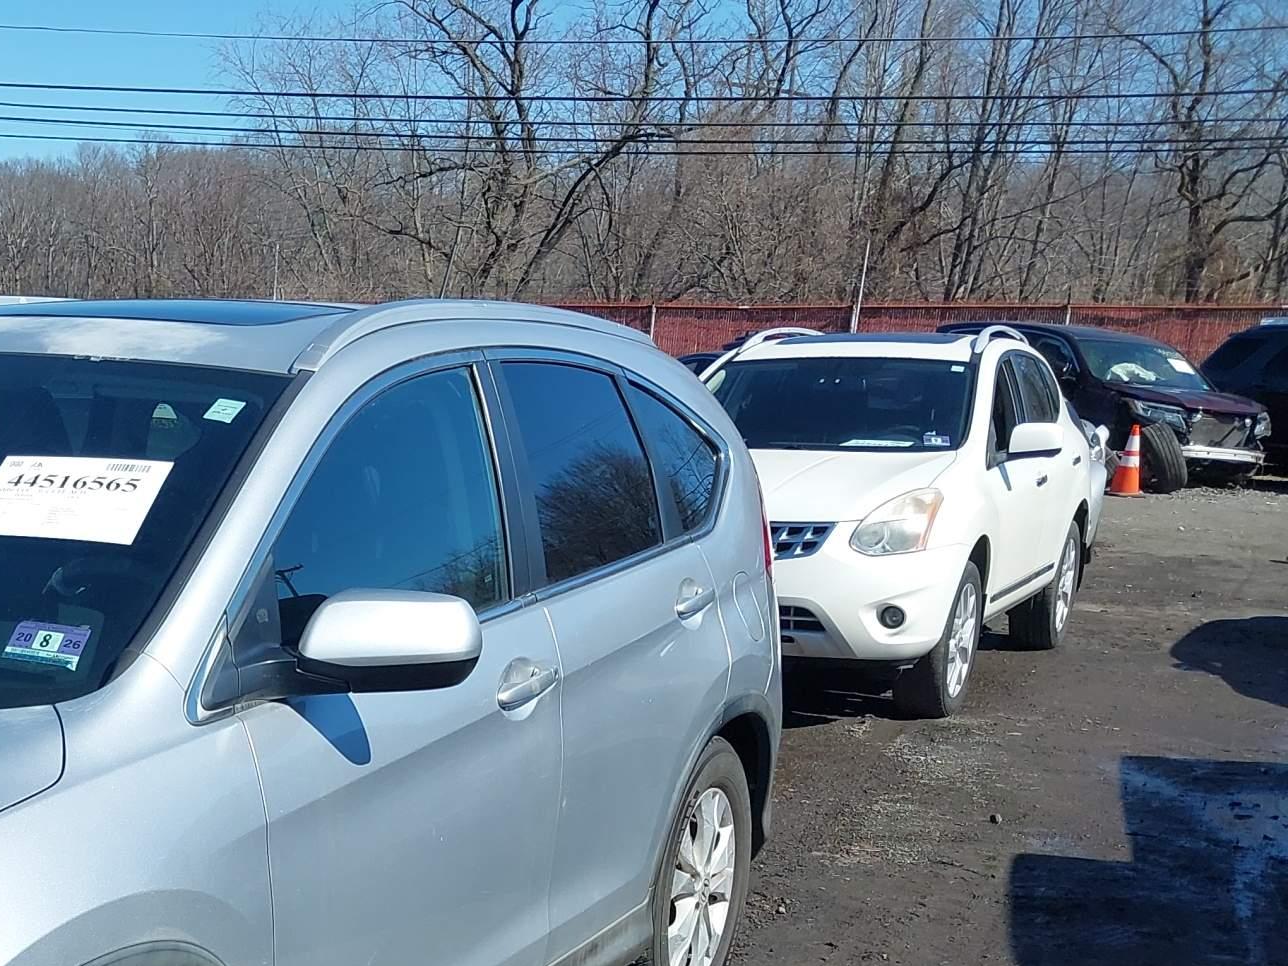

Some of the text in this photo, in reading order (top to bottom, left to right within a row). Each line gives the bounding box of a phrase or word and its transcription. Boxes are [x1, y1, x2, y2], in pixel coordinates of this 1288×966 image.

[8, 473, 142, 493] 44516565
[16, 632, 82, 650] 20 8 26
